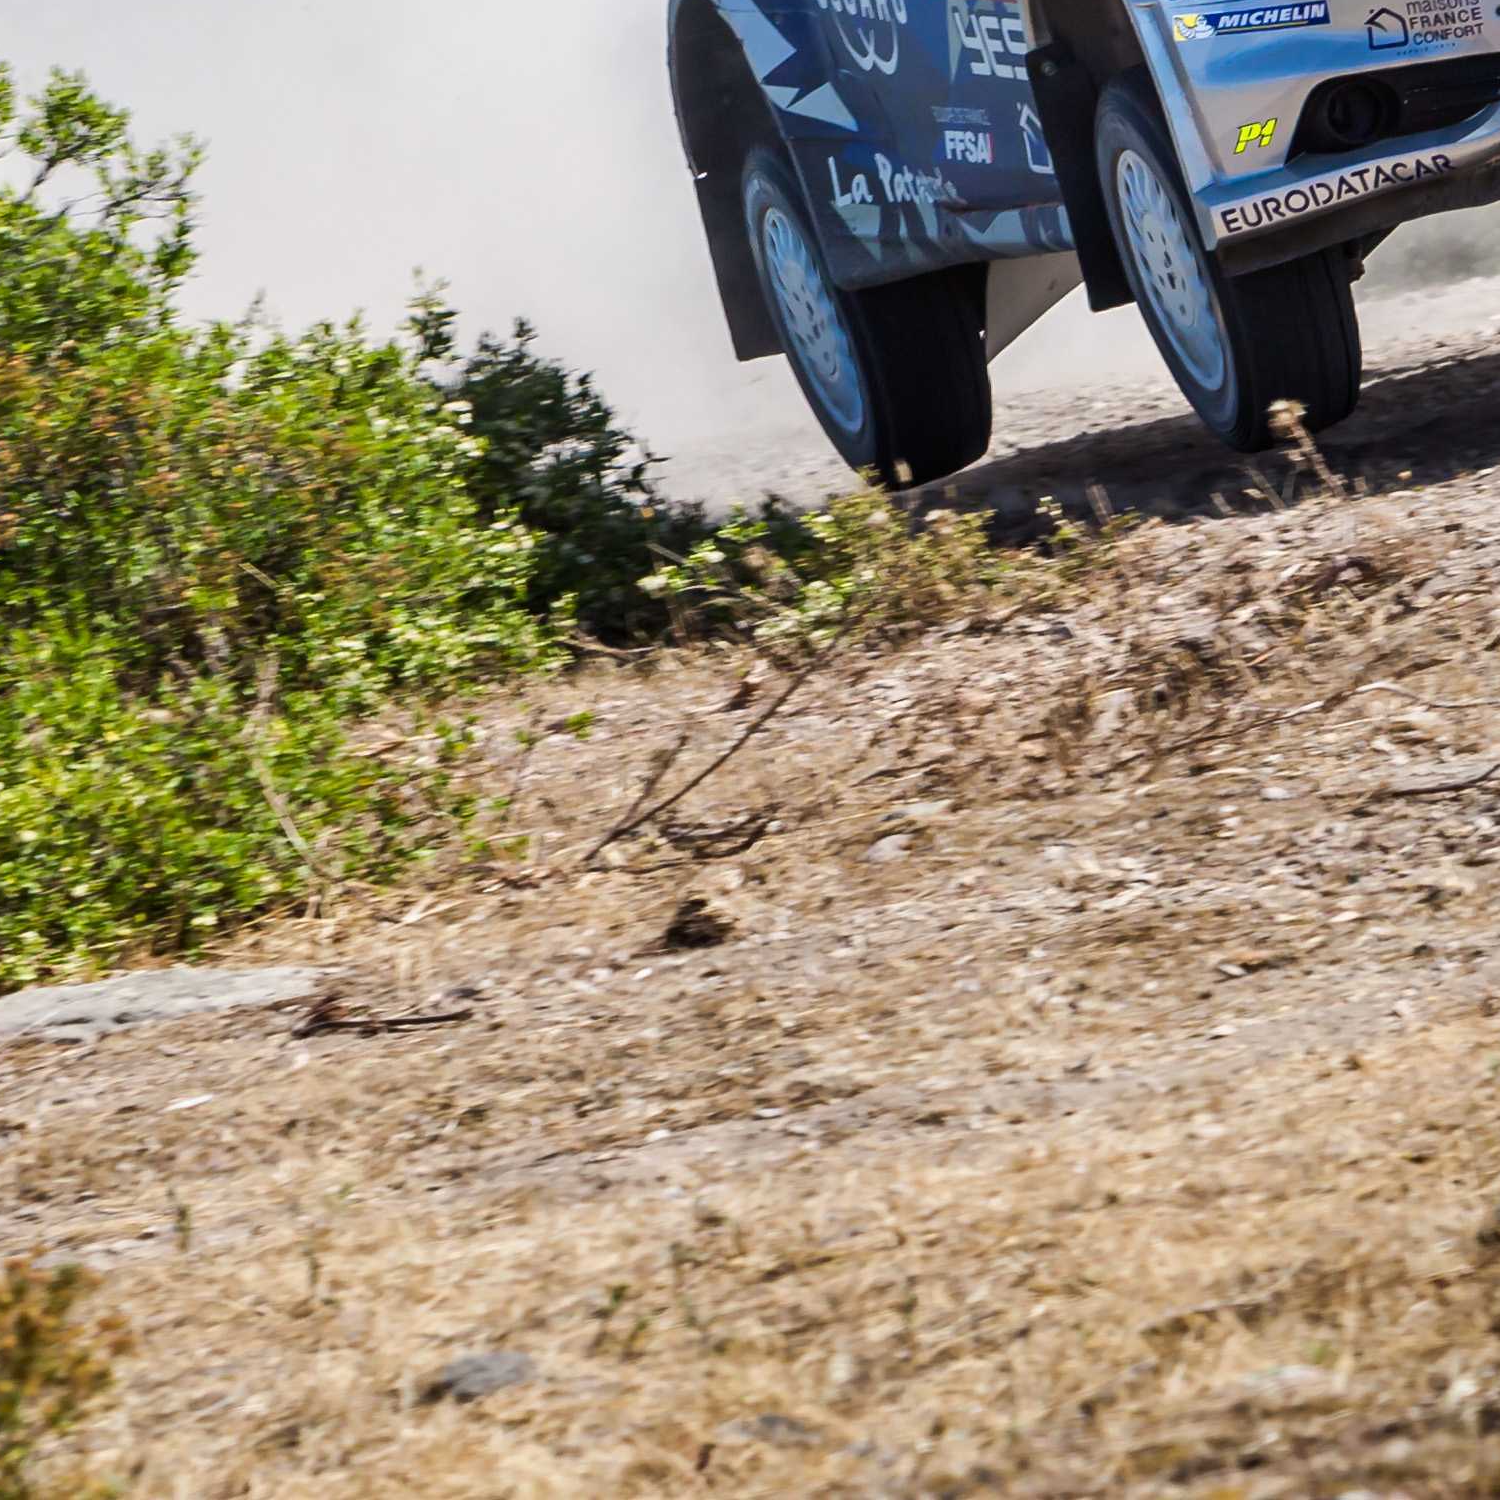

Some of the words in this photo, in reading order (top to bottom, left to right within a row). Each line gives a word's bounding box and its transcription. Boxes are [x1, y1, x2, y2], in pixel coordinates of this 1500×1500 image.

[1217, 3, 1325, 29] MICHELIN
[1409, 6, 1483, 30] FRANCE
[1412, 22, 1485, 45] CONFORT
[943, 130, 990, 164] FFSA
[1233, 117, 1278, 154] P1
[828, 155, 873, 207] La
[1220, 153, 1457, 233] EURODATACAR
